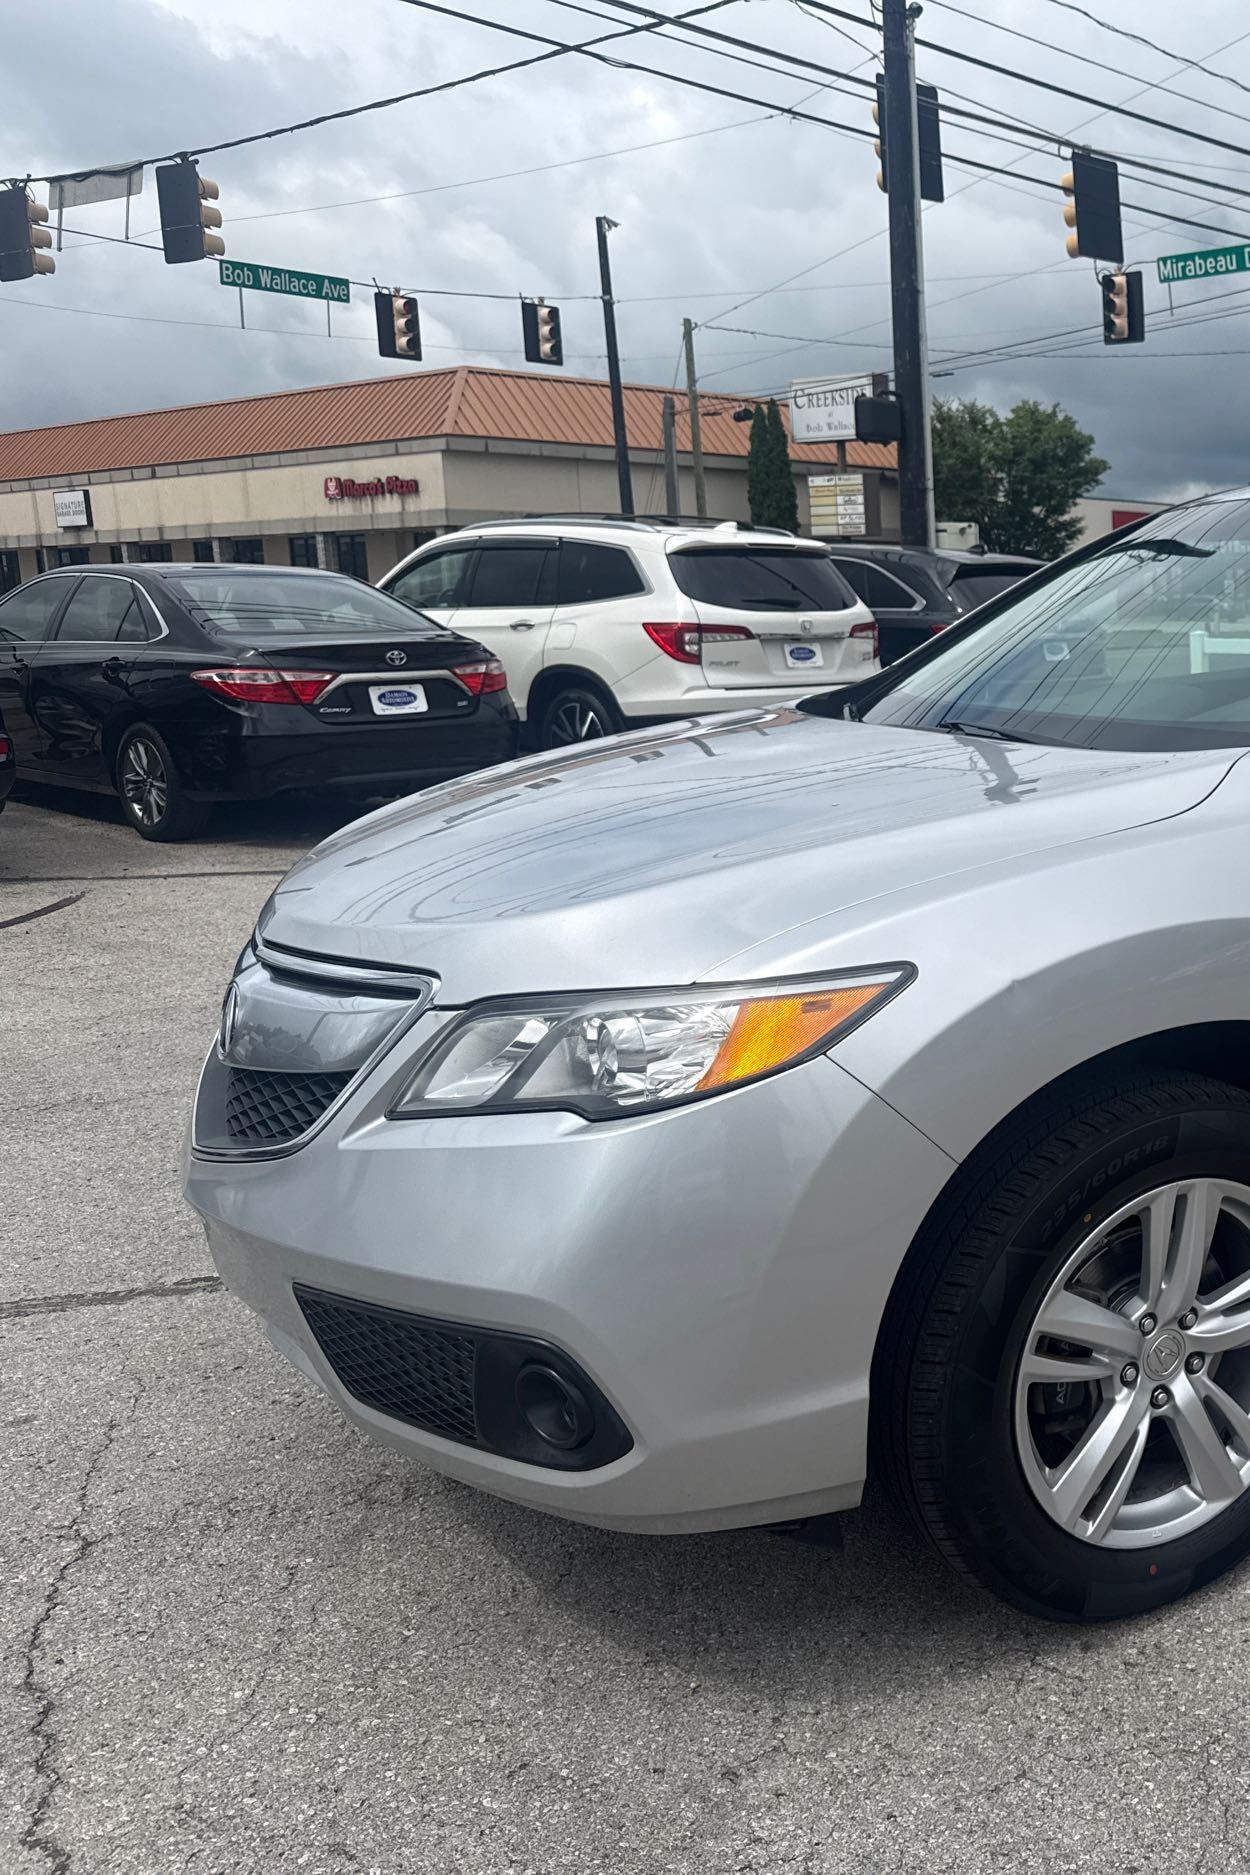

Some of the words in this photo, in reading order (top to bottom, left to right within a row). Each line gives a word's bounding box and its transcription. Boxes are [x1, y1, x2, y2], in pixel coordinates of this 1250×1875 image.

[1160, 255, 1237, 280] Mirabeau
[222, 263, 253, 285] Bob
[259, 268, 317, 295] Wallace
[322, 279, 348, 299] Ave
[342, 478, 385, 497] Marco's
[385, 476, 419, 495] Pizza
